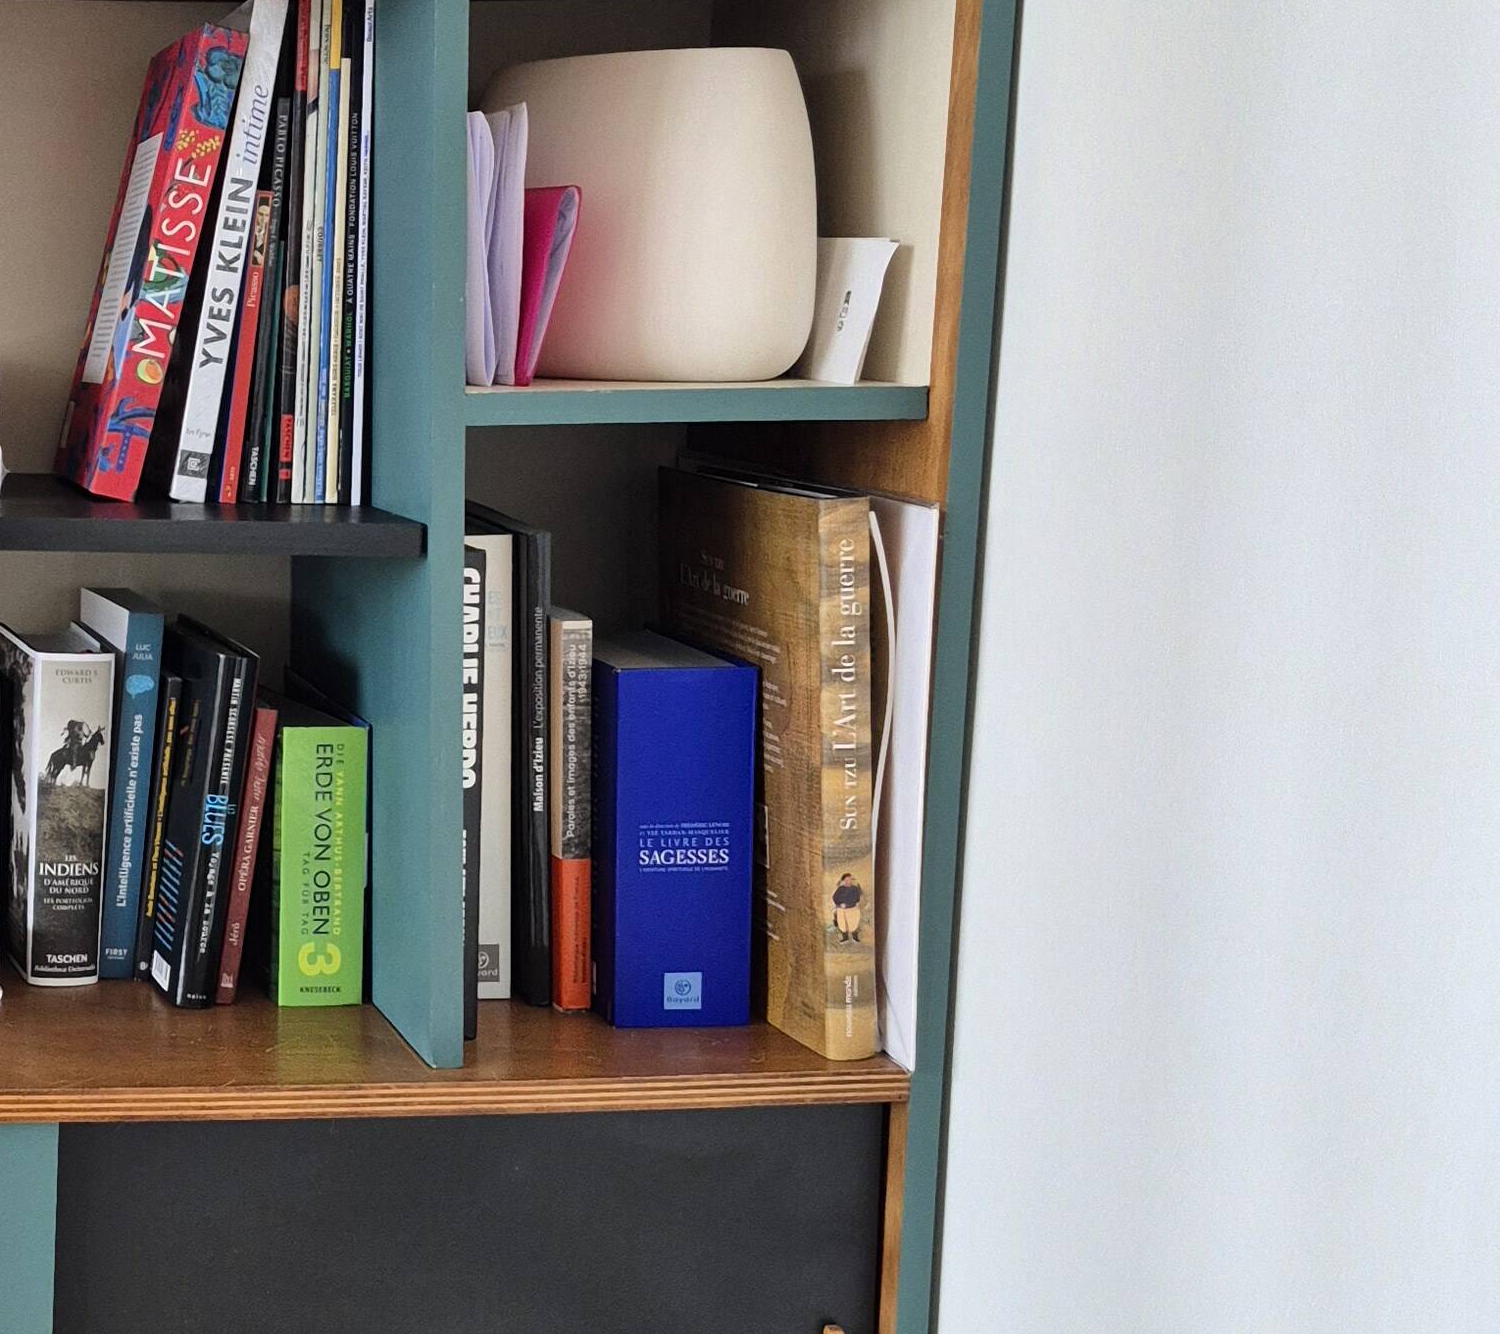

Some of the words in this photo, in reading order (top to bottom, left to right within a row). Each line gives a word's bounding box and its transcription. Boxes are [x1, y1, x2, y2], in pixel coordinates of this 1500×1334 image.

[235, 83, 270, 165] intime
[274, 113, 289, 153] PABLO
[350, 111, 359, 149] VUITTON
[272, 156, 285, 208] PICASSO
[349, 151, 358, 177] LOUIS
[348, 178, 357, 227] FONDATION
[215, 175, 255, 276] KLEIN
[131, 156, 213, 360] MATISSE
[246, 270, 260, 309] Picasso
[346, 263, 355, 297] QUATRE
[197, 286, 234, 371] YVES
[344, 311, 354, 348] WARHOL
[342, 356, 352, 399] BASQUIAT
[247, 445, 260, 486] TASCHEN
[838, 538, 863, 616] guerre
[135, 643, 150, 651] LUC
[533, 606, 546, 668] permanente
[830, 624, 856, 647] la
[55, 668, 92, 676] EDWARD
[132, 652, 153, 661] JULIA
[566, 643, 577, 679] d'Izieu
[830, 654, 856, 682] de
[61, 676, 93, 684] CURTIS
[230, 678, 242, 705] MARTIN
[532, 669, 546, 730] L'exposition
[566, 680, 577, 721] enfants
[132, 713, 144, 734] pas
[225, 707, 239, 744] SCORSESE
[566, 722, 577, 742] des
[831, 688, 857, 751] L'Art
[127, 735, 141, 779] n'existe
[335, 743, 346, 766] DIE
[532, 736, 545, 773] d'Izieu
[314, 743, 334, 804] ERDE
[334, 771, 346, 807] YANN
[566, 786, 576, 796] et
[123, 780, 137, 835] artificielle
[532, 774, 545, 813] Maison
[201, 794, 229, 845] BLUES
[242, 804, 259, 854] GARNIER
[313, 807, 333, 861] VON
[566, 798, 577, 838] Paroles
[64, 854, 78, 862] LES
[638, 848, 731, 866] SAGESSES
[639, 837, 654, 848] LE
[660, 837, 699, 848] LIVRE
[704, 836, 731, 848] DES
[38, 861, 99, 877] INDIENS
[43, 877, 94, 887] D'AMÉRIQUE
[115, 836, 132, 908] L'Intelligence
[235, 854, 251, 892] OPÉRA
[301, 852, 311, 876] TAG
[332, 811, 346, 936] ARTHUS-BERTRAND
[49, 886, 62, 895] DU
[64, 886, 89, 895] NORD
[311, 870, 333, 936] OBEN
[300, 912, 311, 936] TAG
[45, 953, 88, 964] TASCHEN
[105, 948, 128, 956] FIRST
[297, 940, 342, 977] 3
[299, 986, 342, 994] KNESEBECK
[666, 995, 700, 1004] Bayard
